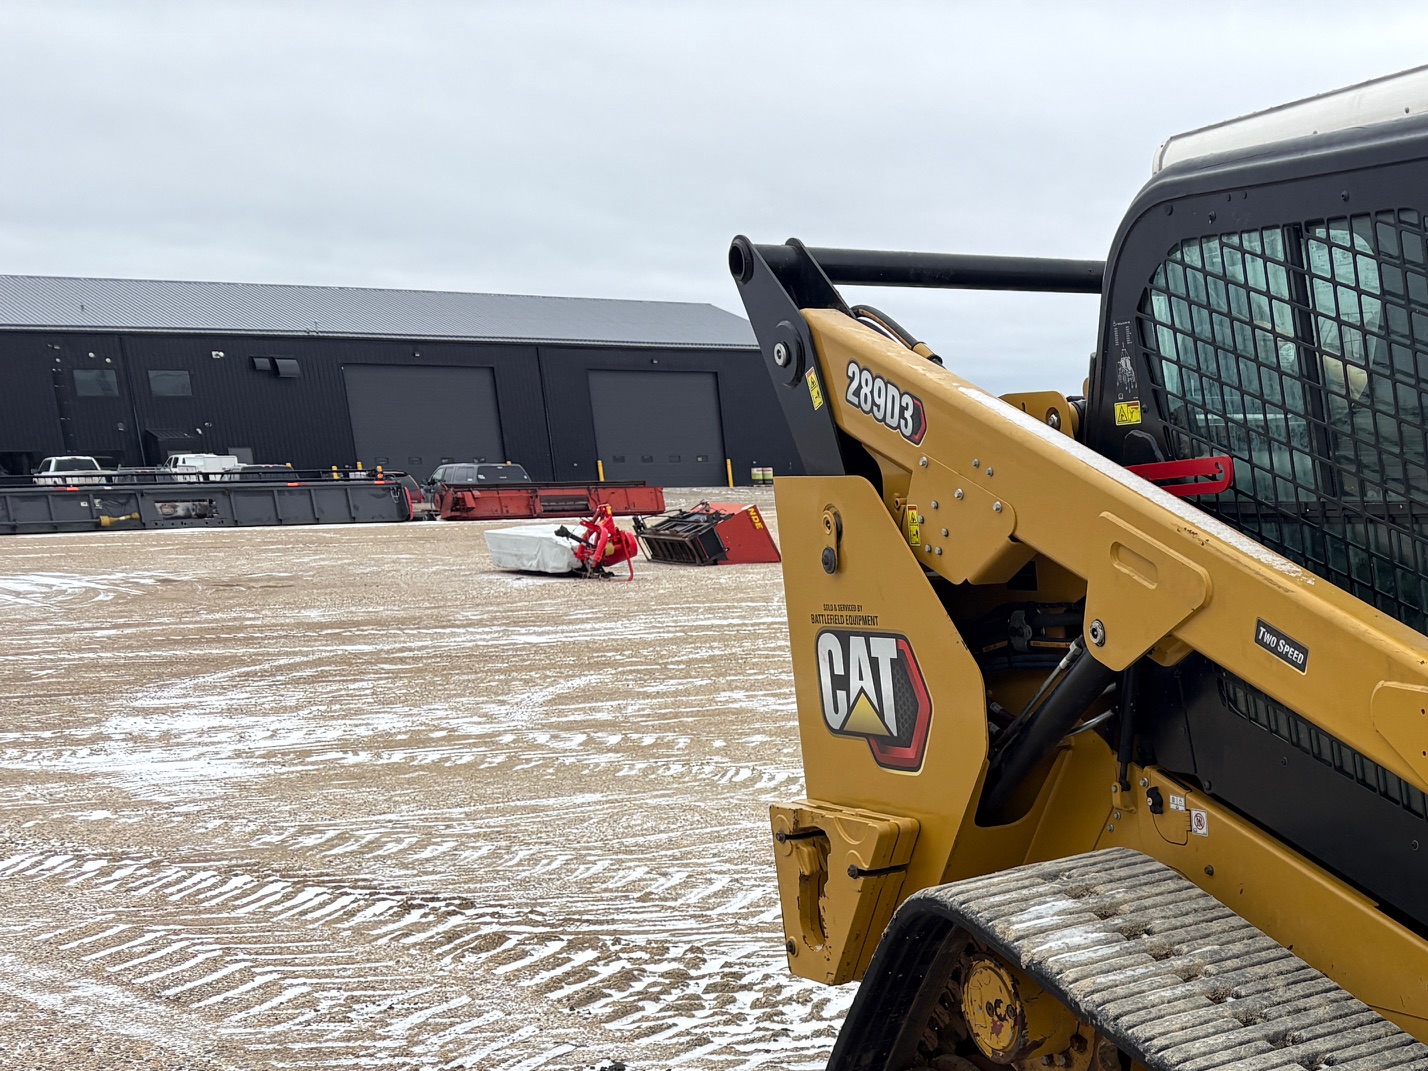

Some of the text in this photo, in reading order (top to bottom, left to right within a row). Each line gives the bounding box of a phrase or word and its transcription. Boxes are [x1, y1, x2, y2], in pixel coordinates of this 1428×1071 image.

[846, 361, 914, 437] 289D3
[811, 614, 878, 626] BATTLEFIELD EQUIPMENT
[817, 632, 899, 737] CAT
